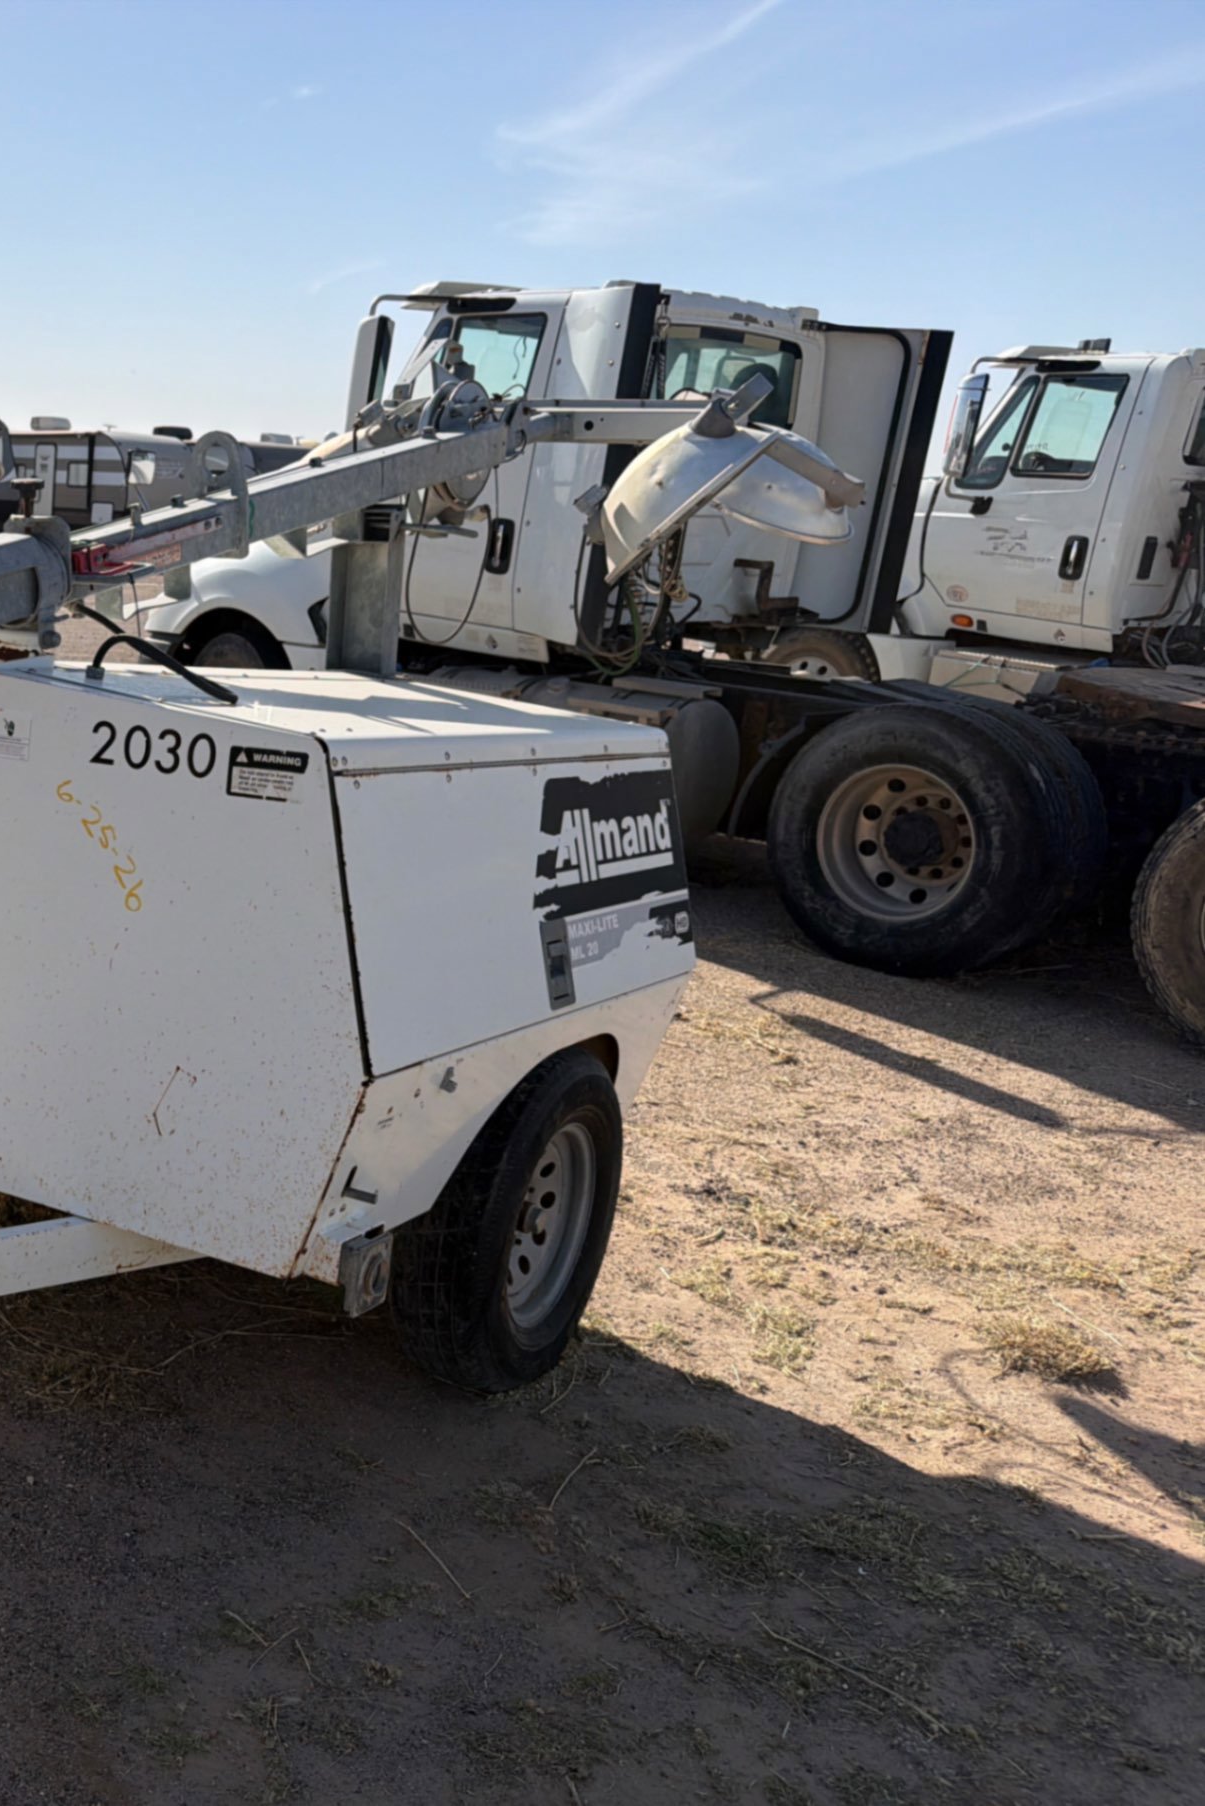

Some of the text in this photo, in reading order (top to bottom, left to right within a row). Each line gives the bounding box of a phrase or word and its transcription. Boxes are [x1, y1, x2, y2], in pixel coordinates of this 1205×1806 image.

[89, 720, 217, 778] 2030
[252, 752, 302, 767] WARNING
[554, 799, 673, 884] Allmand
[567, 913, 619, 939] MAXI-LITE
[570, 945, 586, 959] ML
